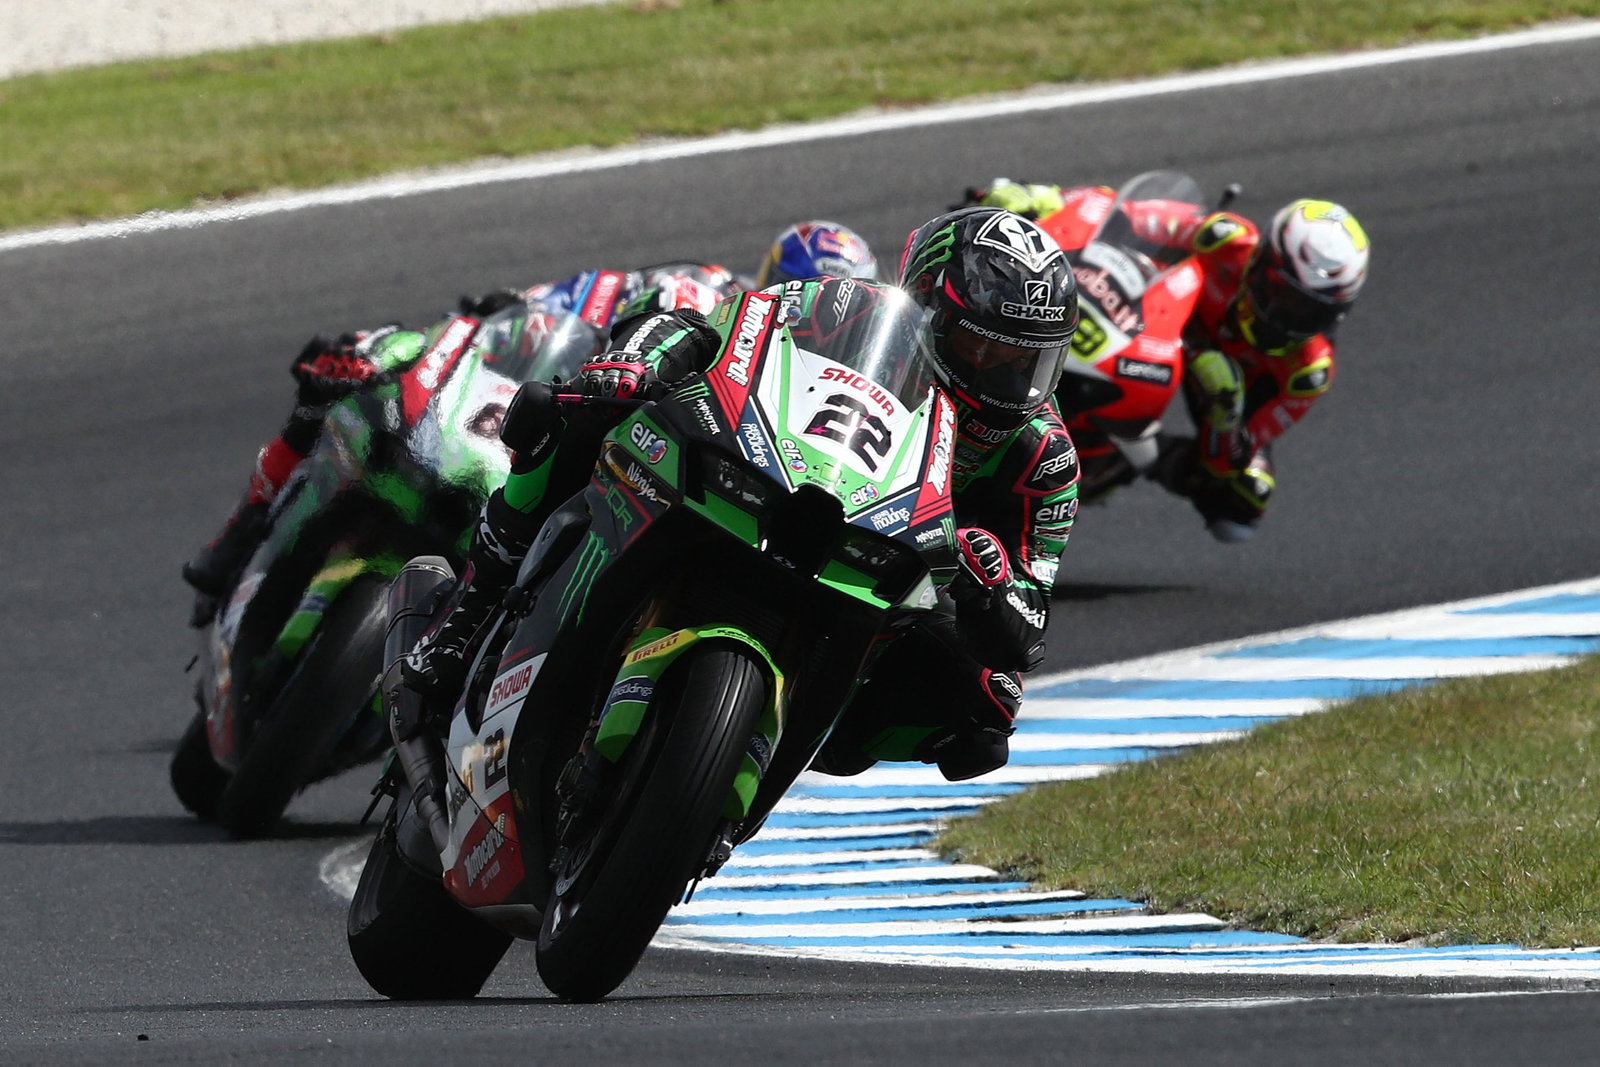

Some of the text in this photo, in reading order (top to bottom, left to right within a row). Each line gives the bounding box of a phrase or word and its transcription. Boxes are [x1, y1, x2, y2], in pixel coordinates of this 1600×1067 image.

[1002, 303, 1065, 320] SHARK
[818, 367, 895, 417] SHOWA
[626, 461, 657, 501] Ninja
[1036, 502, 1069, 521] elf
[631, 633, 681, 662] PIRELLI
[489, 665, 533, 709] SHOWA
